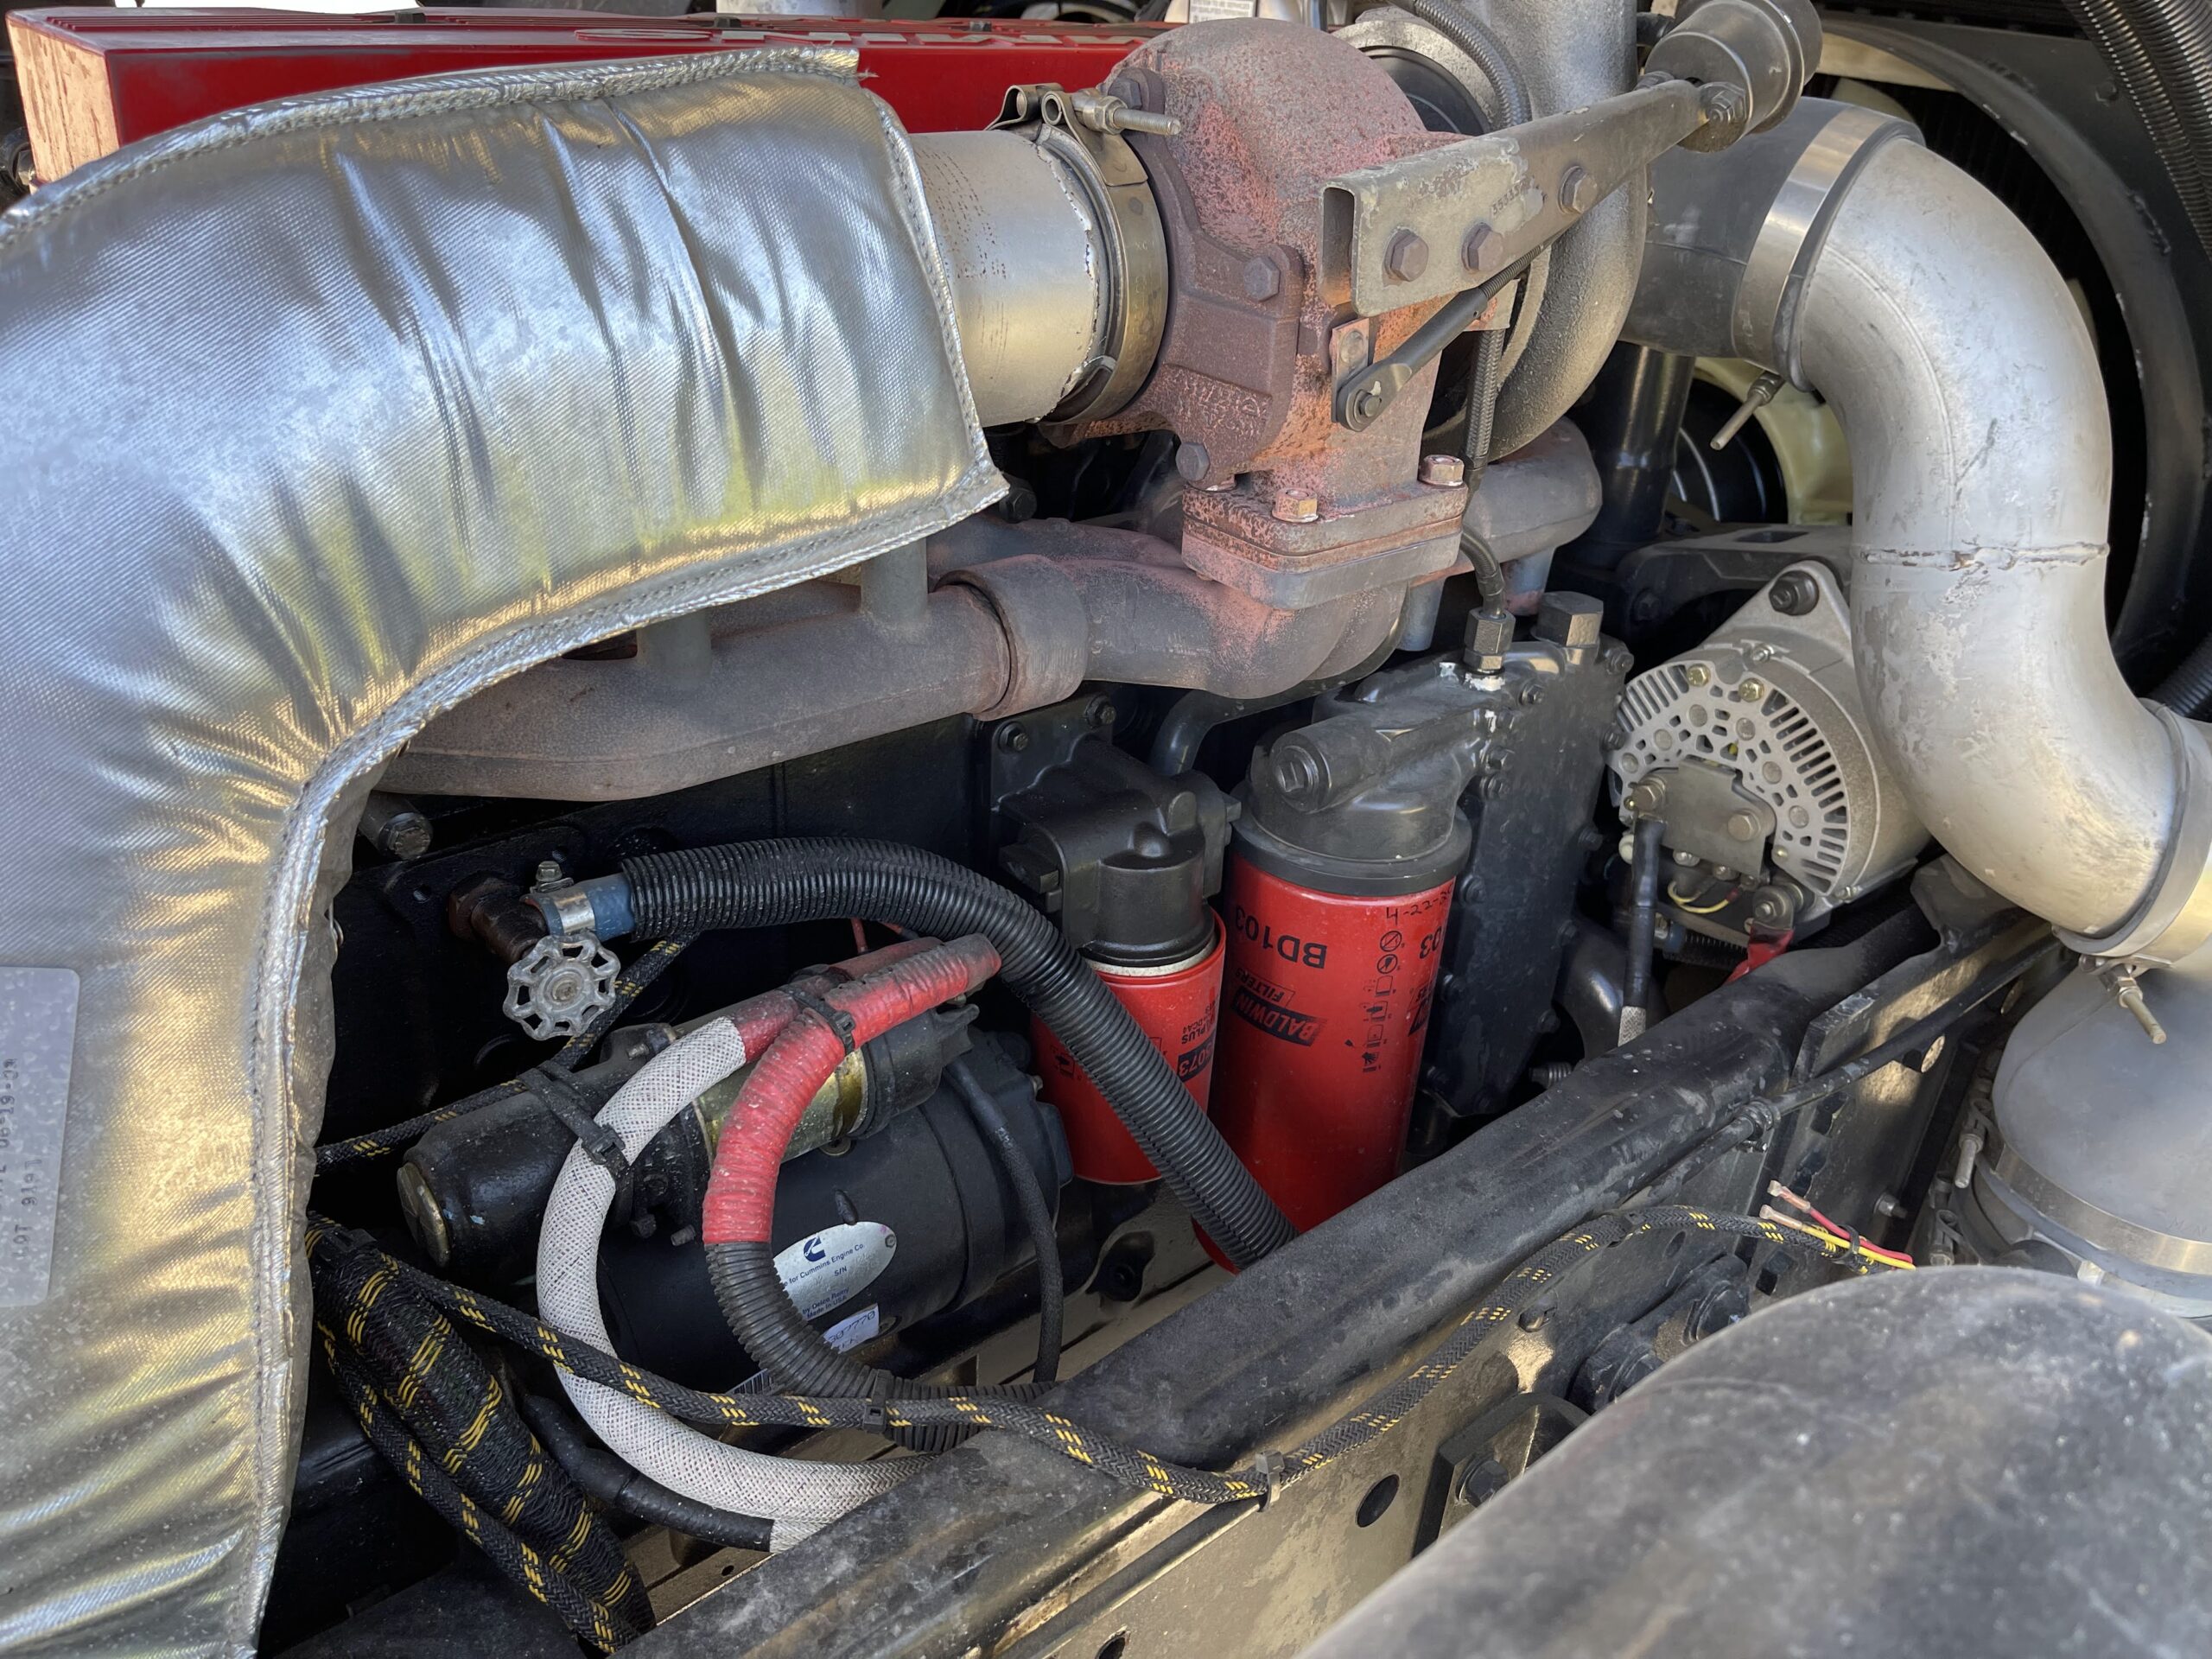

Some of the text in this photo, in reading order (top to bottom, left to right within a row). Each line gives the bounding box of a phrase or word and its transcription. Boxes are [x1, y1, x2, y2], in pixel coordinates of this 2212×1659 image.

[1236, 906, 1328, 969] BD103
[1235, 968, 1284, 1002] FILTERS
[1236, 994, 1319, 1041] BALDWIN
[1181, 1027, 1206, 1045] PLUS
[789, 1274, 799, 1285] for
[799, 1260, 831, 1279] Cummins
[831, 1249, 854, 1264] Engine
[834, 1266, 849, 1277] S/N
[833, 1294, 849, 1306] USA
